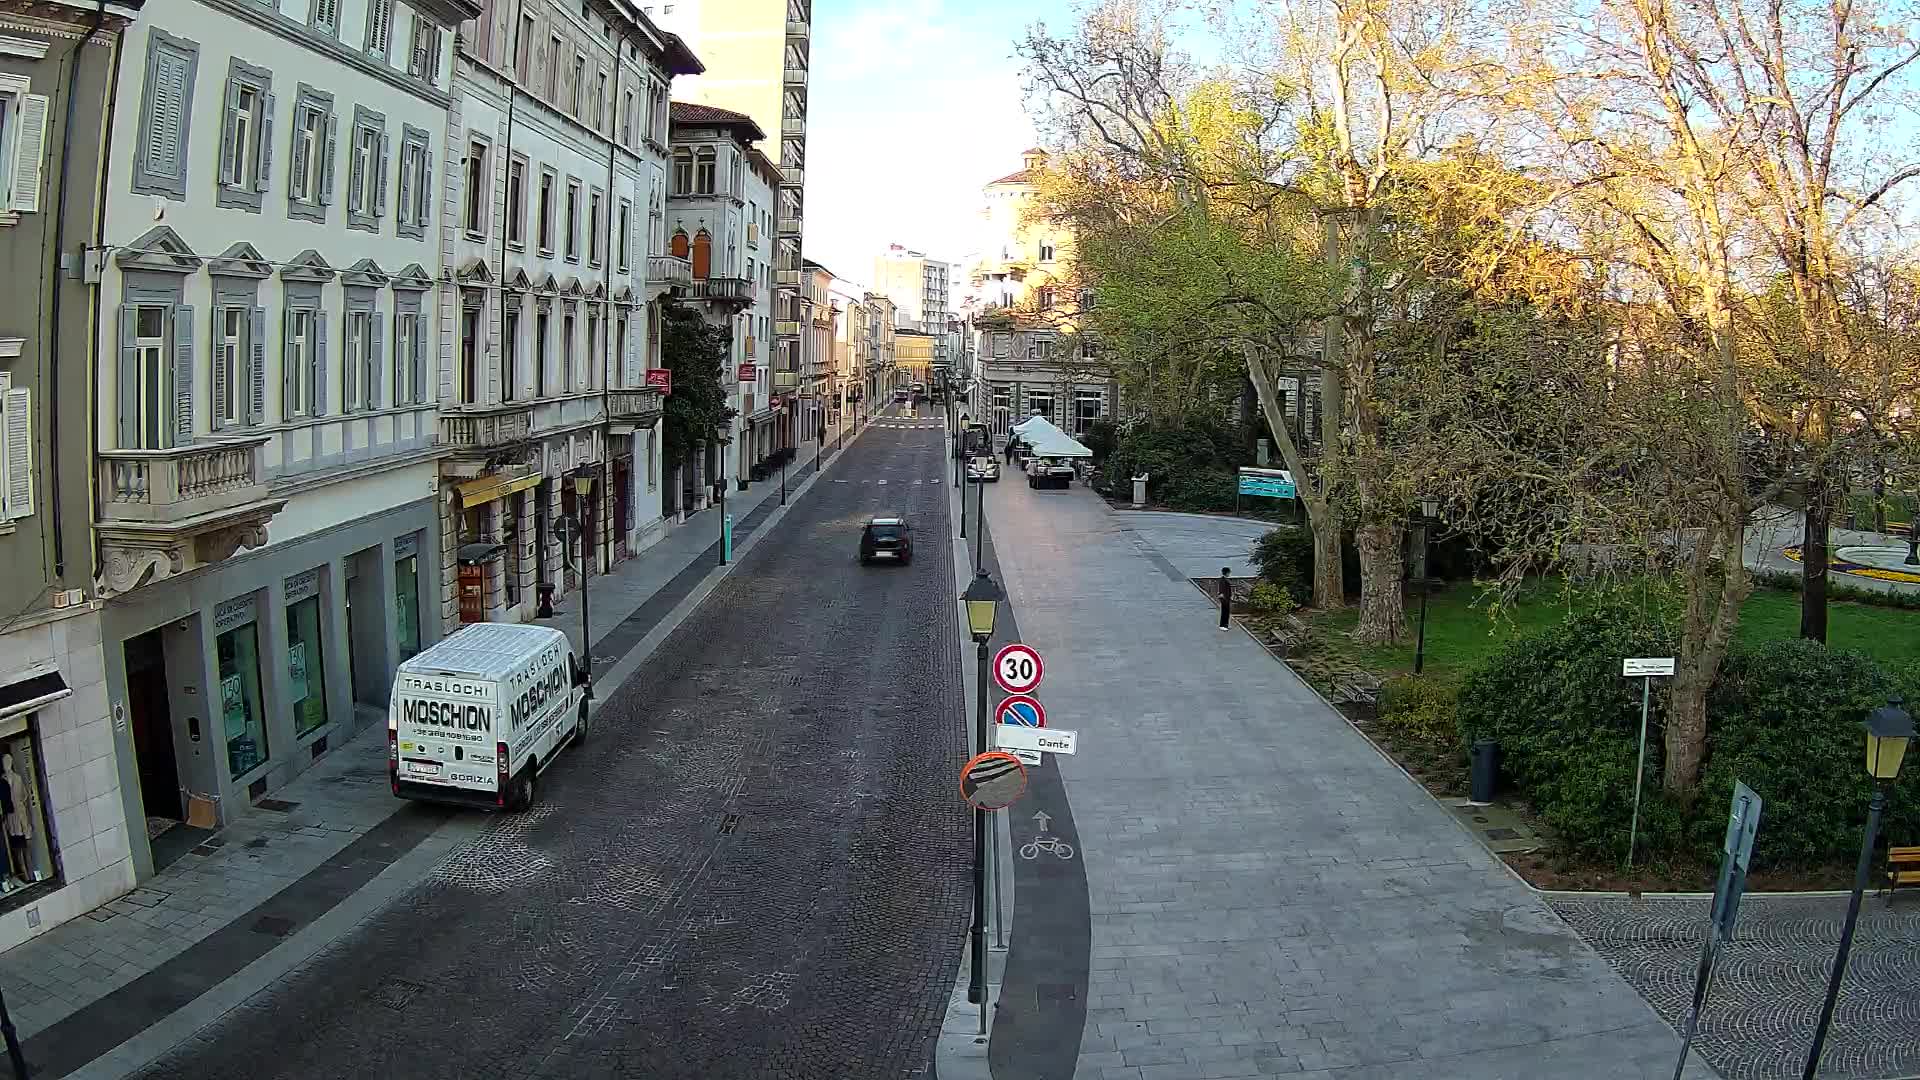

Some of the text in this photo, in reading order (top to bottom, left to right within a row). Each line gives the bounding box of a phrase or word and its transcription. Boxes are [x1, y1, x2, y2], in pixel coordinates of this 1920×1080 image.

[510, 641, 561, 691] TRASLOCHI
[1006, 658, 1033, 680] 30
[405, 679, 488, 696] TRASLOCHI
[510, 660, 568, 732] MOSCHION
[403, 698, 490, 733] MOSCHION
[1038, 738, 1069, 749] Dante
[450, 773, 495, 785] GORIZIA
